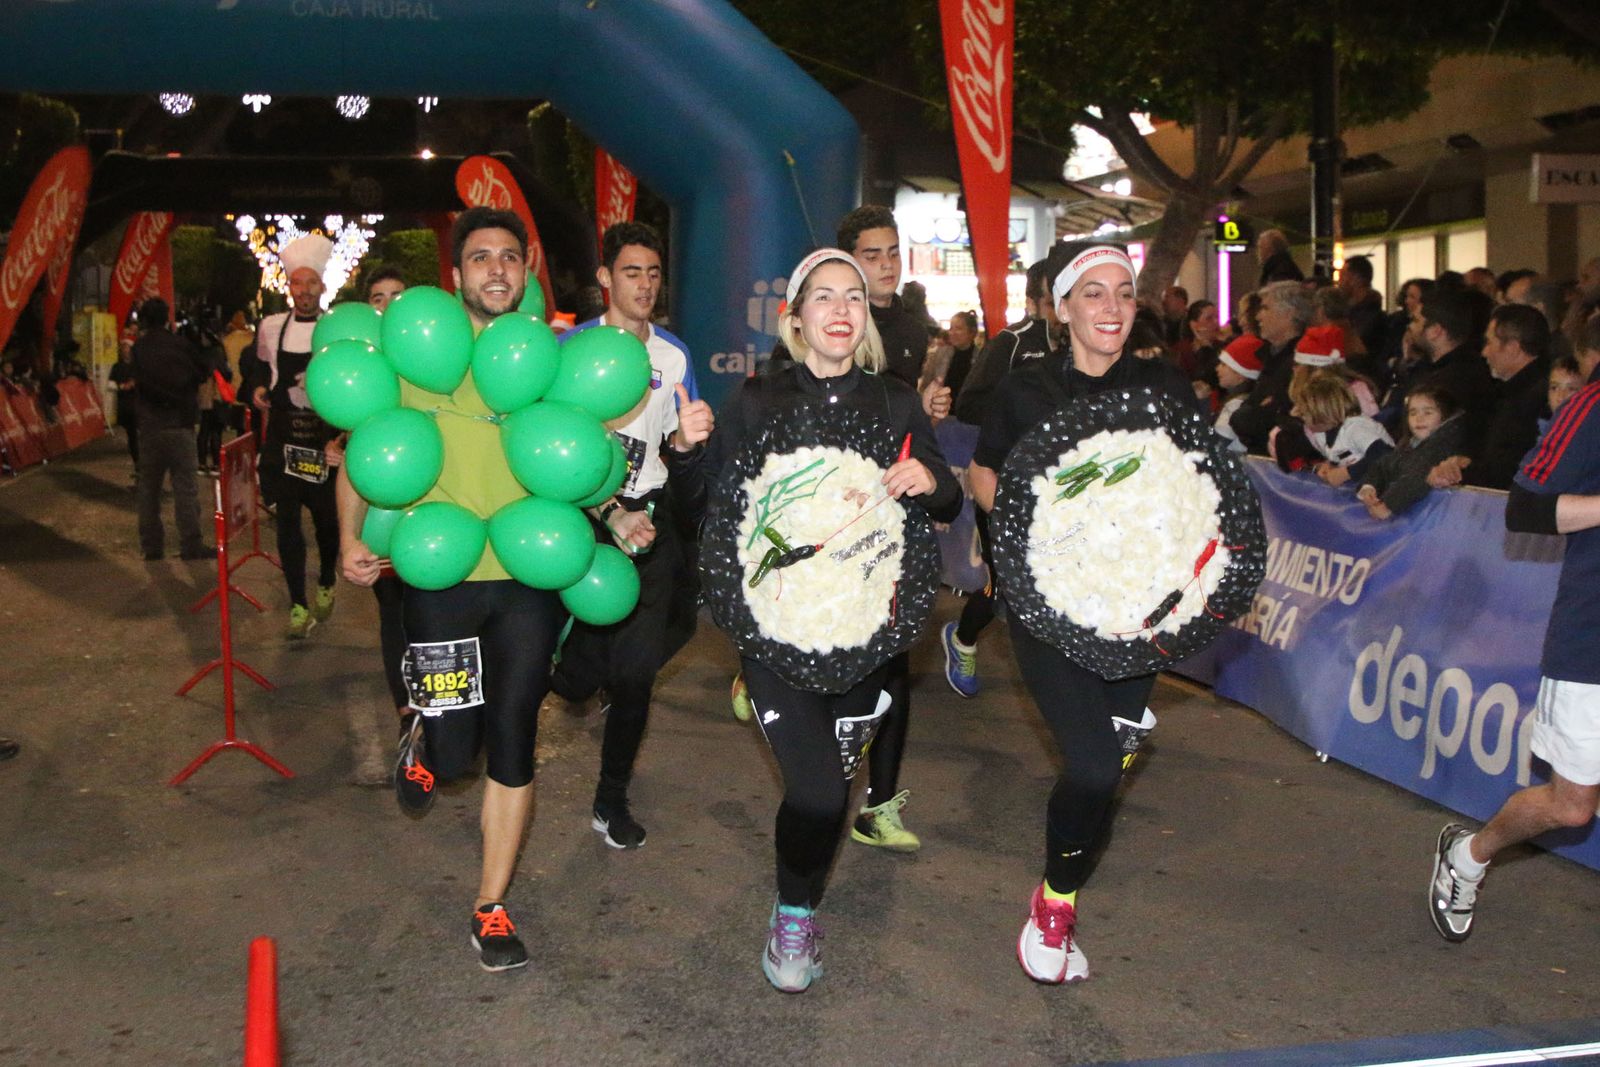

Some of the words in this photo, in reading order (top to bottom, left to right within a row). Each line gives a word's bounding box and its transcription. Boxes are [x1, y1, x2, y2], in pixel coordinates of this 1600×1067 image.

[291, 0, 350, 18] CAJA
[361, 0, 440, 21] RURAL
[298, 461, 321, 475] 2205
[422, 670, 469, 692] 1892
